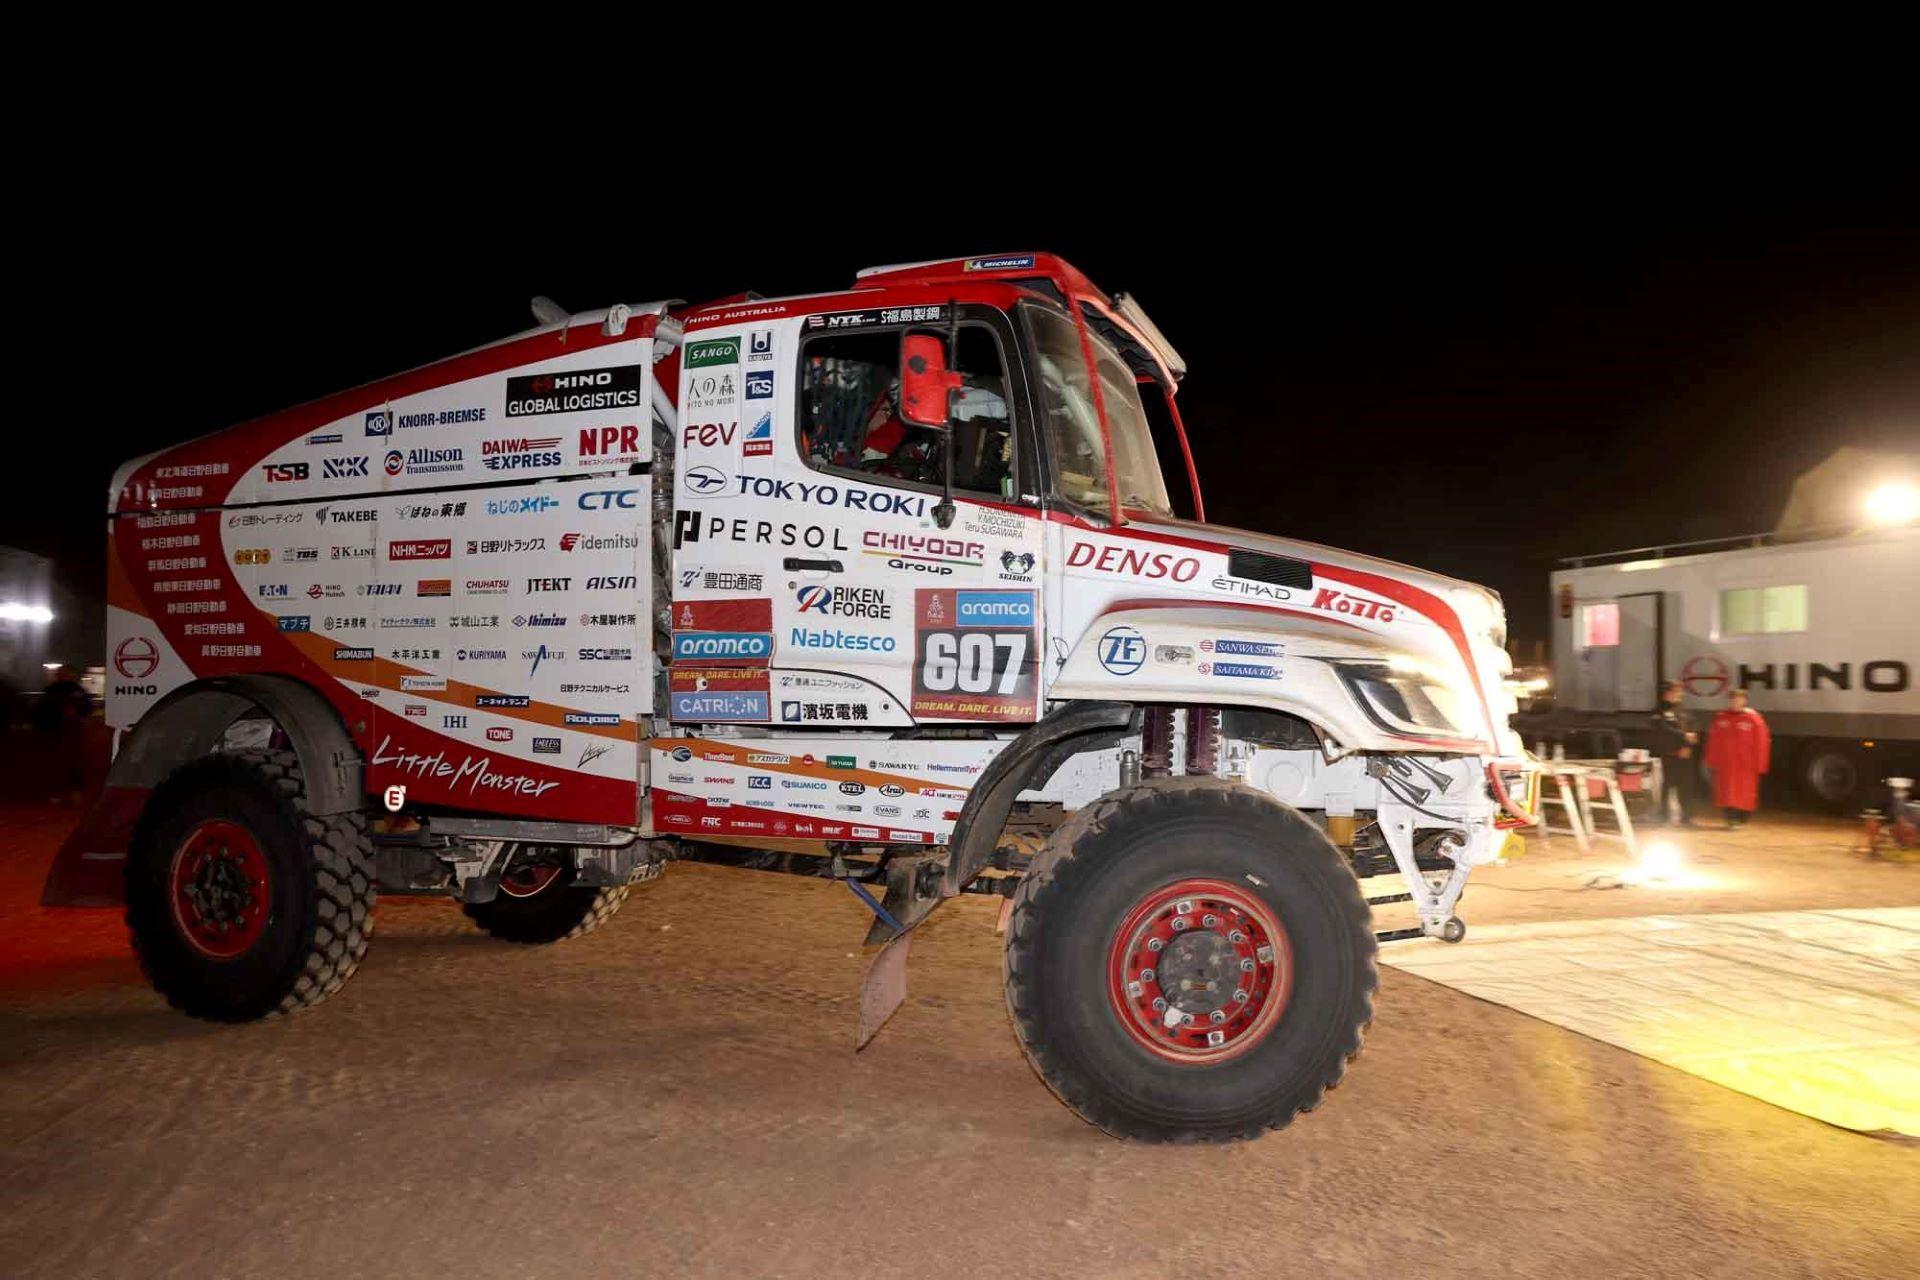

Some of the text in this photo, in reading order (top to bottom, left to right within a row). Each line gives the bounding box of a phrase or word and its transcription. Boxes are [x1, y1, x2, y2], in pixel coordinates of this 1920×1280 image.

[984, 259, 1029, 268] MICHELIN
[689, 306, 786, 324] HINO AUSTRALIA
[828, 315, 863, 325] NYK
[691, 346, 732, 360] SANGO
[555, 372, 612, 389] HINO
[689, 374, 735, 399] 人の森
[508, 390, 638, 415] GLOBAL LOGISTICS
[398, 408, 487, 429] KNORR-BREMSE
[482, 438, 529, 455] DAIWA
[579, 425, 639, 456] NPR
[406, 448, 463, 464] Allison
[490, 452, 562, 470] EXPRESS
[262, 462, 310, 483] TSB
[405, 463, 464, 474] Transmission
[578, 489, 641, 510] CTC
[736, 475, 925, 517] TOKYO ROKI
[410, 502, 467, 518] ばねの東郷
[487, 495, 559, 515] ねじのメイドー
[242, 512, 302, 526] 日野トレーディング
[331, 510, 378, 522] TAKEBE
[709, 517, 848, 550] PERSOL
[981, 524, 1023, 539] SUGAWARA
[481, 538, 545, 554] 日野リトラックス
[581, 534, 639, 550] idemitsu
[341, 547, 376, 557] K LINE
[887, 559, 953, 576] Group
[1066, 541, 1201, 583] DENSO
[466, 580, 510, 588] CHUHATSU
[586, 576, 637, 590] AISIN
[703, 571, 764, 590] 豊田通商
[998, 573, 1033, 583] SEISHIN
[527, 578, 572, 595] JTEKT
[833, 586, 884, 604] RIKEN
[832, 601, 892, 620] FORGE
[961, 603, 1030, 615] aramco
[590, 614, 637, 627] 木屋製作所
[681, 638, 764, 655] aramco
[791, 627, 896, 652] Nabtesco
[1217, 641, 1253, 653] SANWA
[469, 650, 507, 660] KURIYAMA
[579, 648, 603, 660] SSC
[1104, 635, 1141, 665] ZF
[923, 632, 1027, 694] 607
[1215, 665, 1258, 675] SAITAMA
[1739, 660, 1911, 692] HINO
[115, 685, 157, 695] HINO
[560, 684, 630, 694] 日野テクニカルサービス
[802, 703, 869, 721] 濱坂電機
[914, 701, 956, 711] DREAM.
[958, 703, 991, 714] DARE.
[993, 705, 1018, 715] LIVE
[443, 715, 468, 728] IHI
[488, 728, 512, 740] TONE
[449, 755, 560, 799] Monster
[704, 776, 735, 784] SWANS
[790, 781, 827, 790] SUMICO
[388, 790, 400, 806] E
